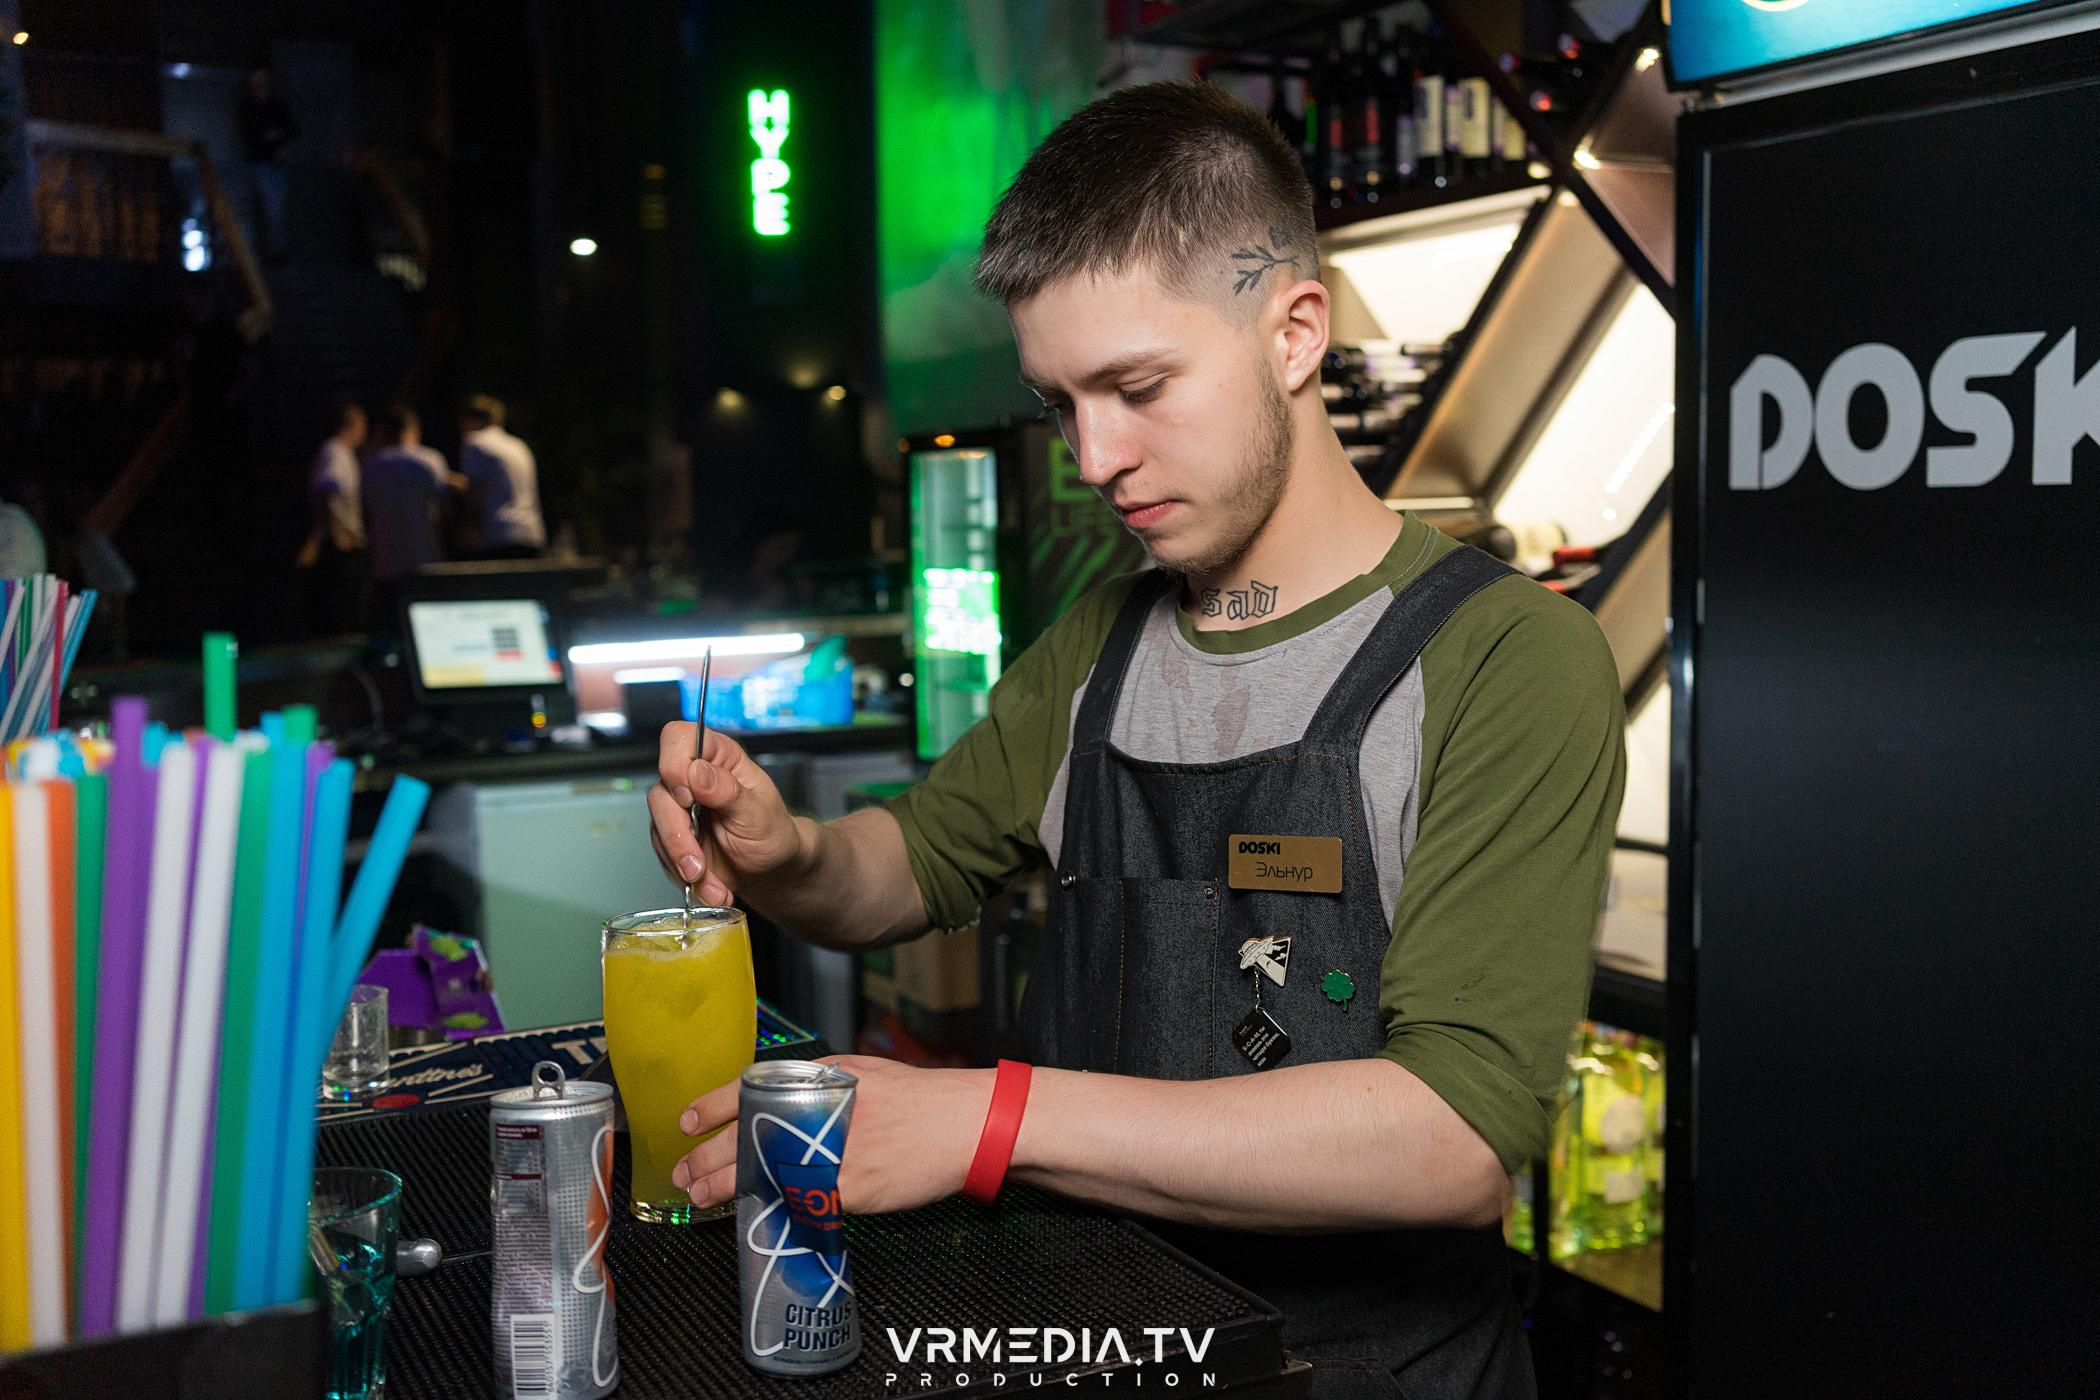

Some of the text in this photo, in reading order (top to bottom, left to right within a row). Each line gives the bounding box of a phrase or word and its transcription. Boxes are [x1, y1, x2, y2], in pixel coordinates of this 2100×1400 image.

[748, 89, 790, 236] HYPE
[1202, 580, 1279, 620] sad
[1238, 841, 1281, 856] DOSKI
[1256, 861, 1314, 883] Эльнур
[785, 1301, 852, 1329] CITRUS
[783, 1323, 851, 1352] PUNCH
